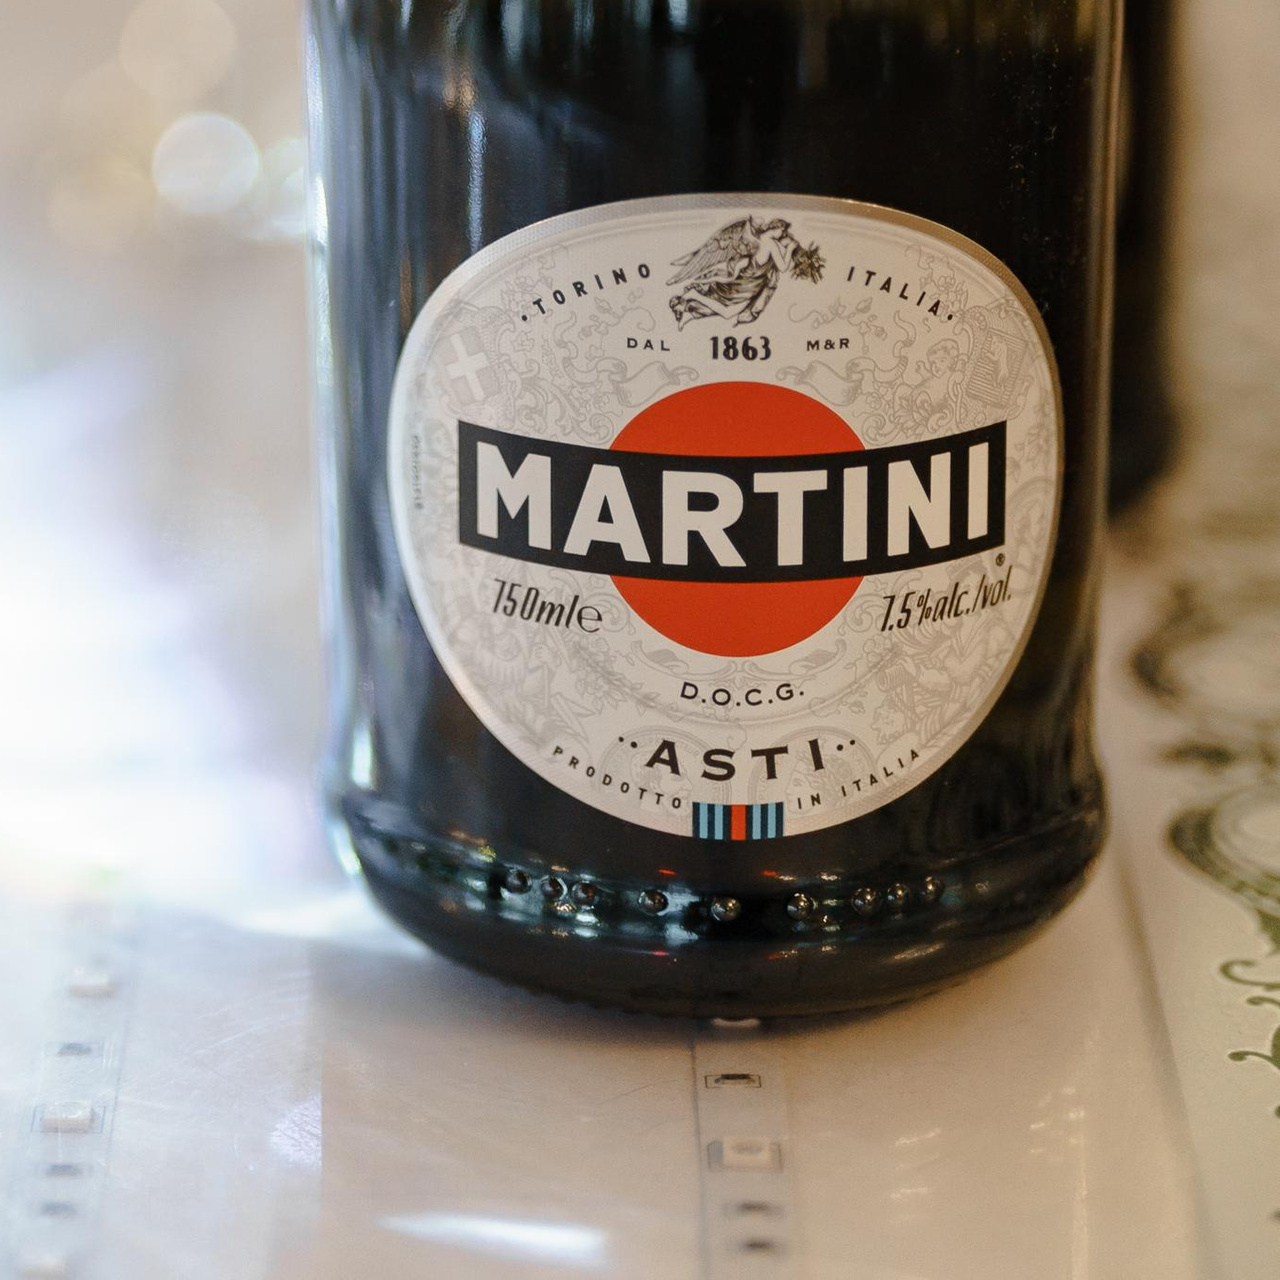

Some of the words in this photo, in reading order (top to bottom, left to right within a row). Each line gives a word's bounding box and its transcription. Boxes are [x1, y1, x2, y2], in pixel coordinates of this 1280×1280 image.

[531, 263, 652, 315] TORINO
[845, 265, 942, 315] ITALIA
[626, 336, 671, 352] DAL
[709, 335, 772, 362] 1863
[806, 336, 851, 352] M&R
[475, 440, 990, 568] MARTINI
[679, 681, 805, 707] D.O.C.G.
[551, 744, 683, 810] PRODOTTO
[643, 737, 826, 782] ASTI
[796, 792, 822, 810] IN
[840, 748, 920, 797] ITALIA
